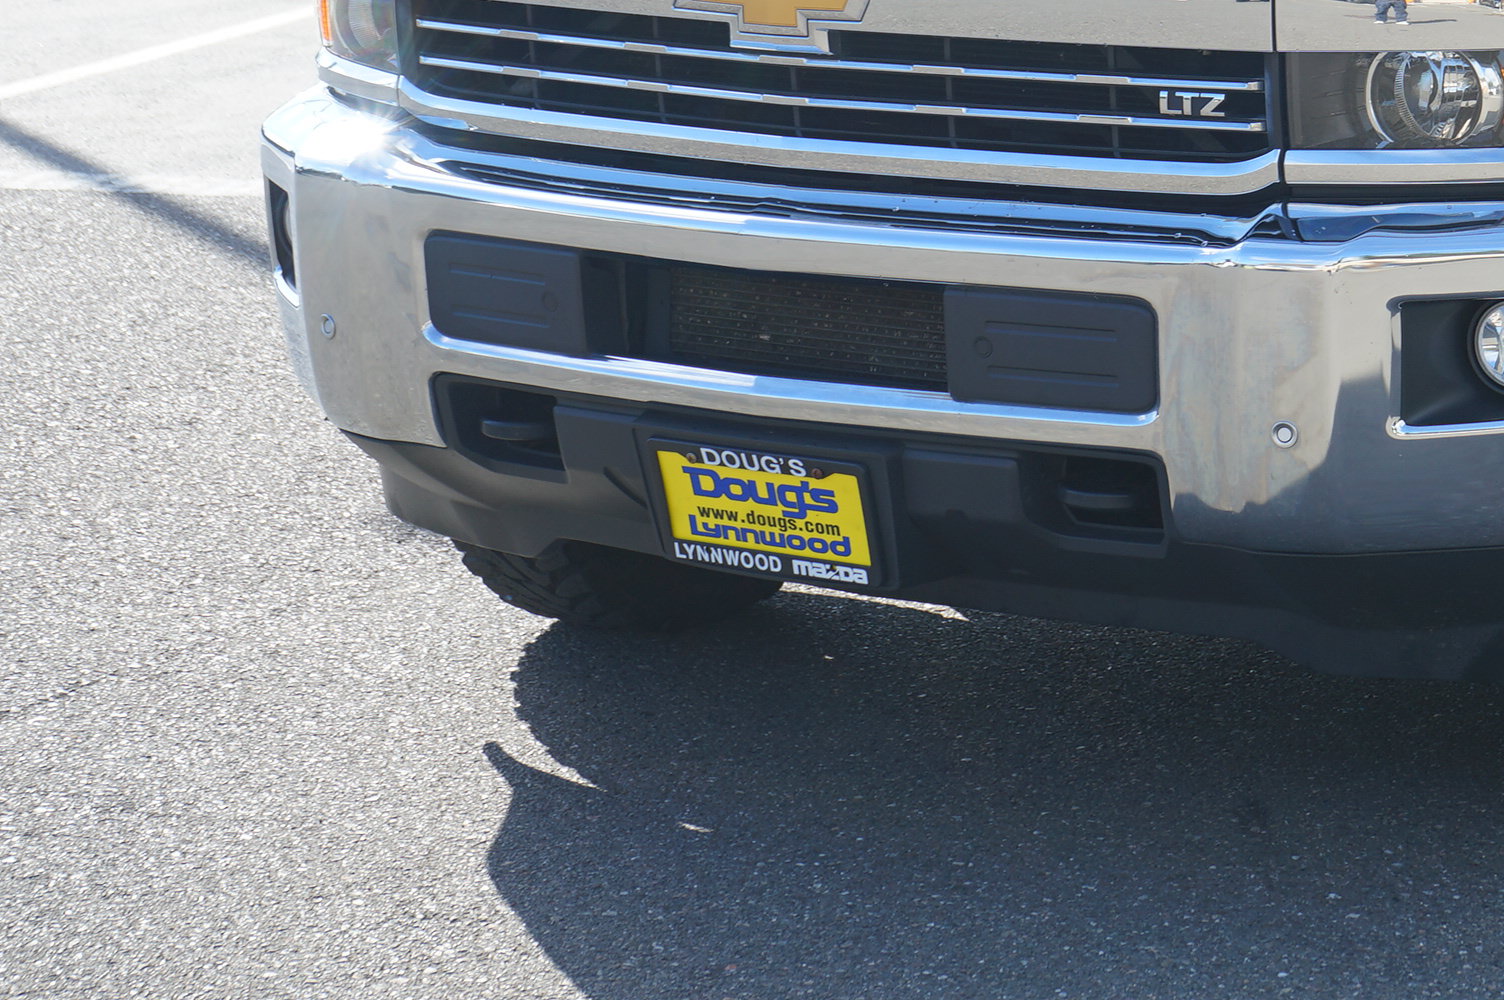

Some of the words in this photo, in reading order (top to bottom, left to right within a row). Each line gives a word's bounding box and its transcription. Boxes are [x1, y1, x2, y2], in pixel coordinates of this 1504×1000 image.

[1159, 90, 1226, 117] LTZ
[700, 447, 807, 478] DOUG'S
[681, 465, 838, 520] Doug's
[688, 513, 852, 557] Lynnwood
[697, 505, 841, 537] www.dougs.com
[673, 541, 782, 573] LYNNWOOD
